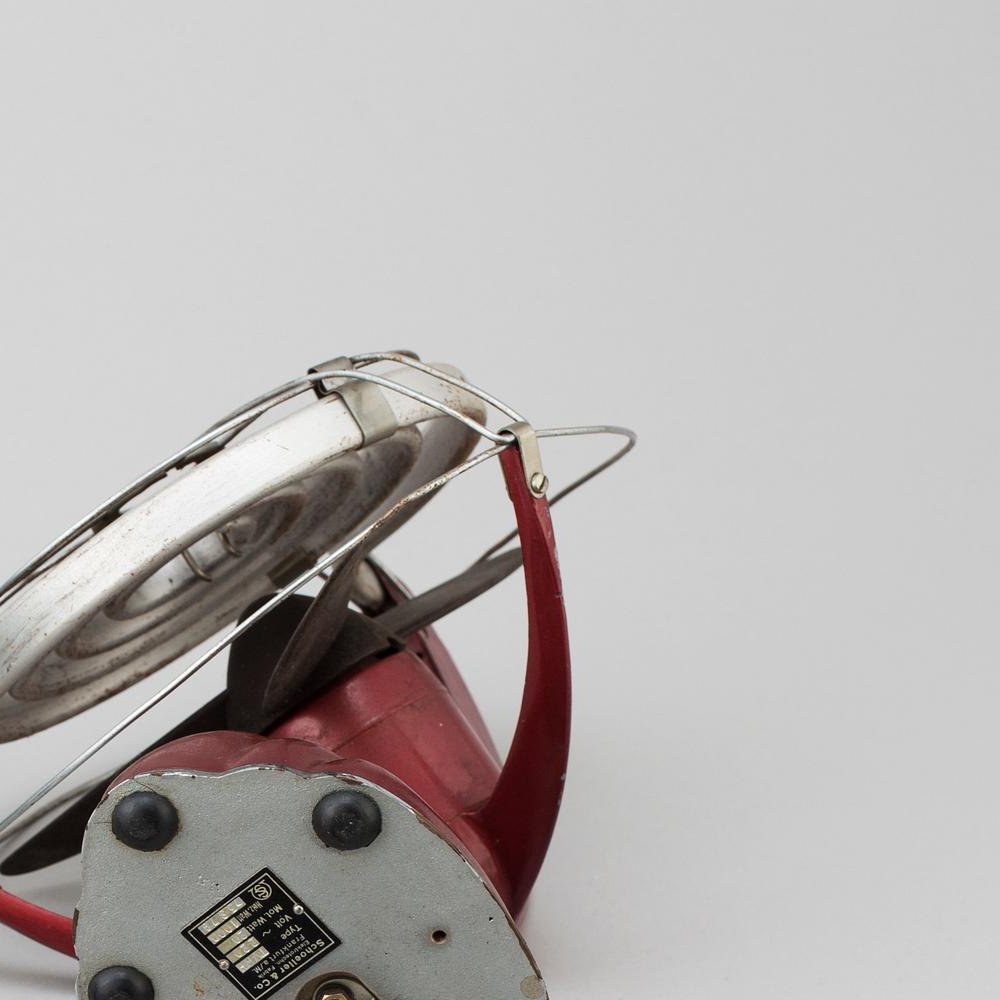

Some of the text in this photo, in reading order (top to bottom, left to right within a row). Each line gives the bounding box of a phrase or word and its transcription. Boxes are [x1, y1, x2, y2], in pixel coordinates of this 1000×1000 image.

[246, 916, 266, 932] Watt
[273, 914, 292, 928] Volt
[280, 924, 302, 940] Type
[269, 933, 305, 961] Frankfurt
[279, 938, 325, 974] Schoeller
[257, 965, 275, 978] Fabrik
[269, 971, 279, 981] &
[253, 978, 271, 991] Co.
